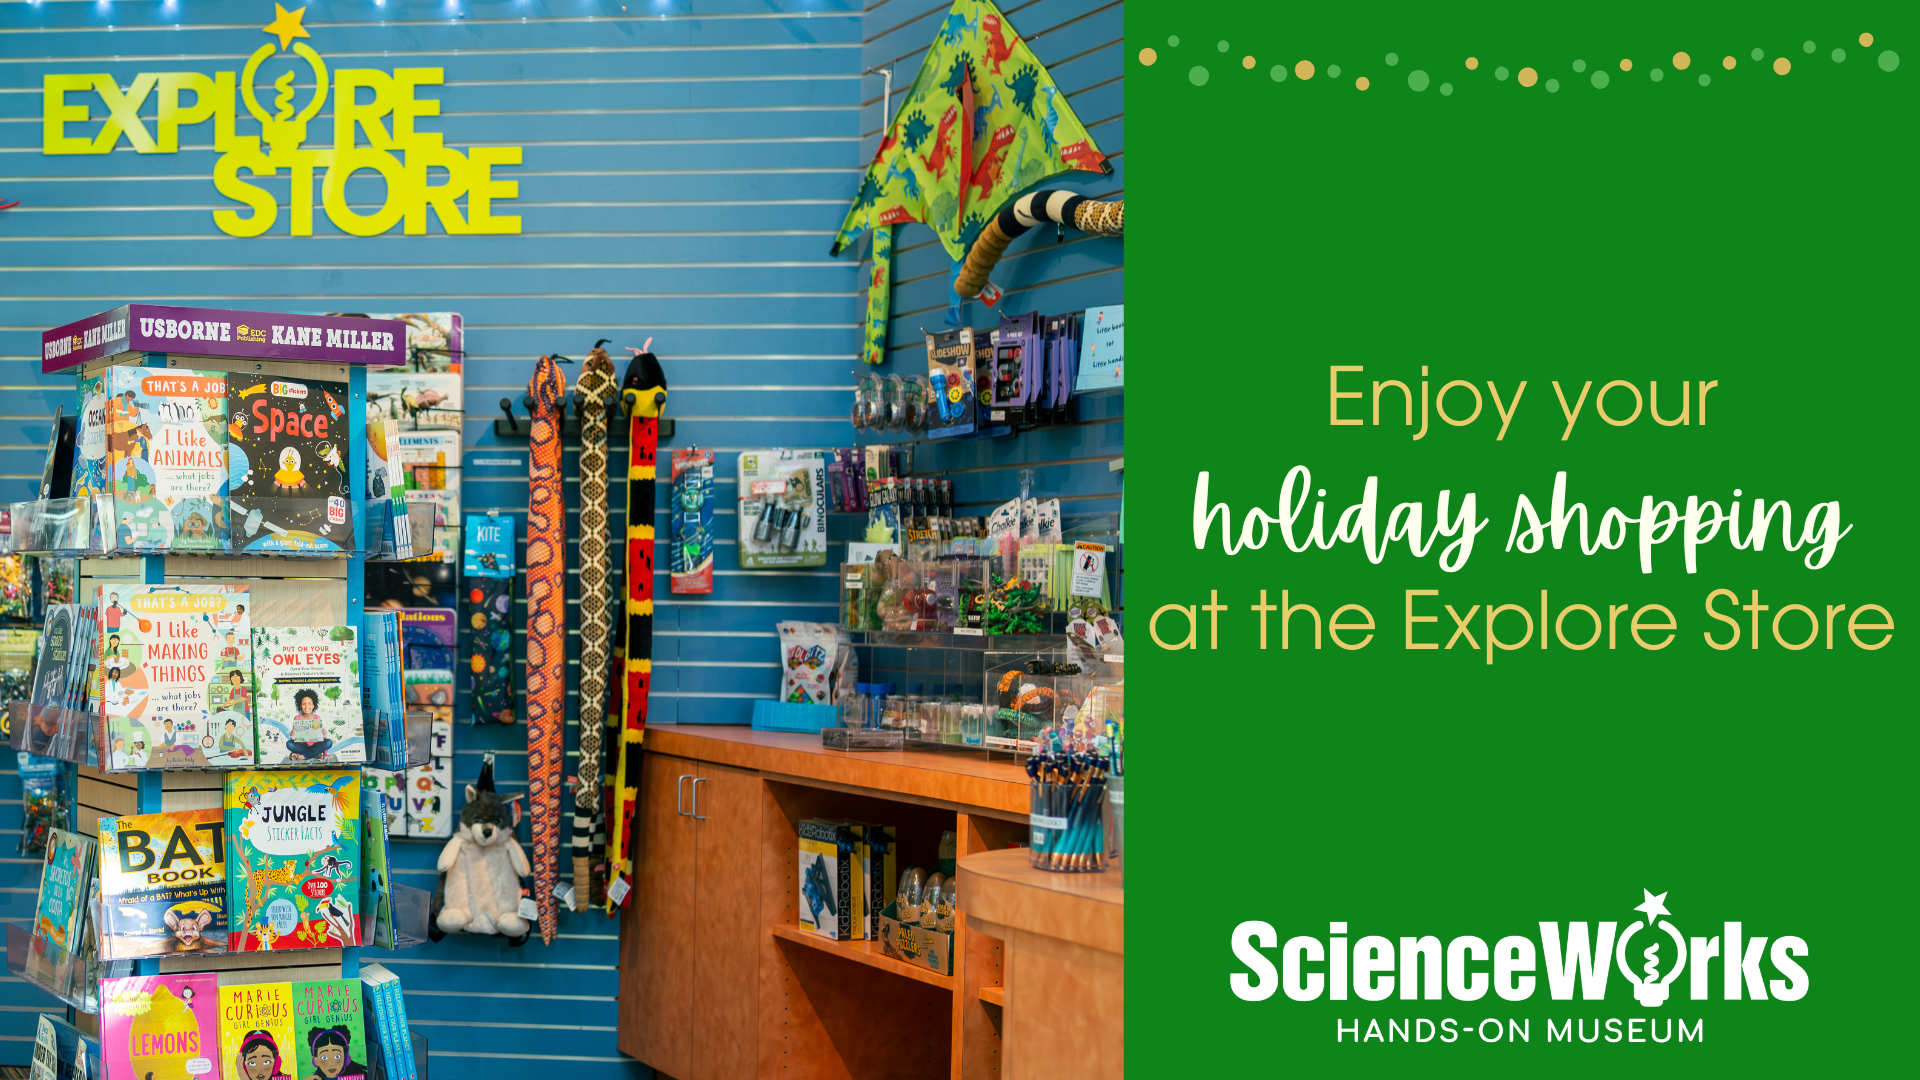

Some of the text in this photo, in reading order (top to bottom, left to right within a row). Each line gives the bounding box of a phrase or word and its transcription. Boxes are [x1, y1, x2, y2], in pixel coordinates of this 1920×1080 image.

[43, 42, 444, 155] EXPLORE
[213, 146, 523, 238] STORE
[44, 336, 72, 360] USBORNE
[83, 326, 101, 349] KANE
[101, 319, 126, 344] MILLER
[140, 318, 394, 351] USBORNE EDC KANE MILLER
[237, 336, 266, 344] Publishing
[930, 343, 971, 359] SLIDESHOW
[147, 380, 228, 394] THAT'S A JOB
[273, 383, 288, 395] BIG
[252, 399, 329, 442] Space
[165, 429, 170, 445] I
[399, 437, 439, 445] ELEMENTS
[154, 449, 223, 468] ANIMALS
[176, 471, 215, 482] what jobs
[186, 482, 211, 492] there?
[333, 499, 345, 508] 40
[816, 467, 825, 533] BINOCULARS
[869, 492, 882, 508] GLOW
[881, 487, 898, 505] GALAXY
[329, 506, 344, 518] BIG
[991, 516, 1016, 533] Chalkie
[1020, 517, 1034, 530] alkie
[477, 526, 501, 543] KITE
[908, 529, 938, 542] STRETCH
[280, 539, 293, 547] giant
[1082, 544, 1104, 552] CAUTION
[136, 596, 221, 609] THAT'S A JOB?
[400, 612, 446, 621] lations
[157, 622, 161, 638] I
[148, 643, 208, 660] MAKING
[272, 653, 341, 666] OWL EYES
[151, 665, 206, 683] THINGS
[162, 690, 201, 702] what jobs
[172, 702, 198, 712] there?
[437, 735, 446, 748] F
[385, 777, 398, 790] P
[417, 777, 432, 791] Q
[389, 798, 426, 811] U V
[261, 805, 327, 823] JUNGLE
[116, 820, 133, 830] The
[421, 817, 434, 830] Z
[799, 822, 836, 841] KidzRobotix
[267, 824, 323, 842] STICKER FACTS
[117, 822, 225, 873] BAT
[49, 865, 72, 887] SECRETOS
[147, 867, 215, 885] BOOK
[307, 881, 328, 890] OVER 100
[311, 889, 326, 897] STICKERS
[118, 895, 139, 905] Afraid
[140, 894, 148, 903] of
[156, 892, 173, 901] BAT?
[174, 889, 198, 899] What's
[199, 888, 209, 897] Up
[210, 887, 226, 895] With
[838, 859, 850, 937] KidzRobotix
[872, 860, 883, 937] KidzRobotix
[898, 927, 915, 942] PALEO
[896, 938, 921, 957] PUZZLERS
[304, 1015, 321, 1025] GIRL
[376, 994, 385, 1021] HELPING
[383, 1035, 392, 1058] PLANET
[385, 991, 395, 1018] HELPING
[393, 1032, 401, 1055] PLANET
[394, 988, 404, 1015] HELPING
[402, 1028, 411, 1051] PLANET
[132, 1031, 199, 1057] LEMONS
